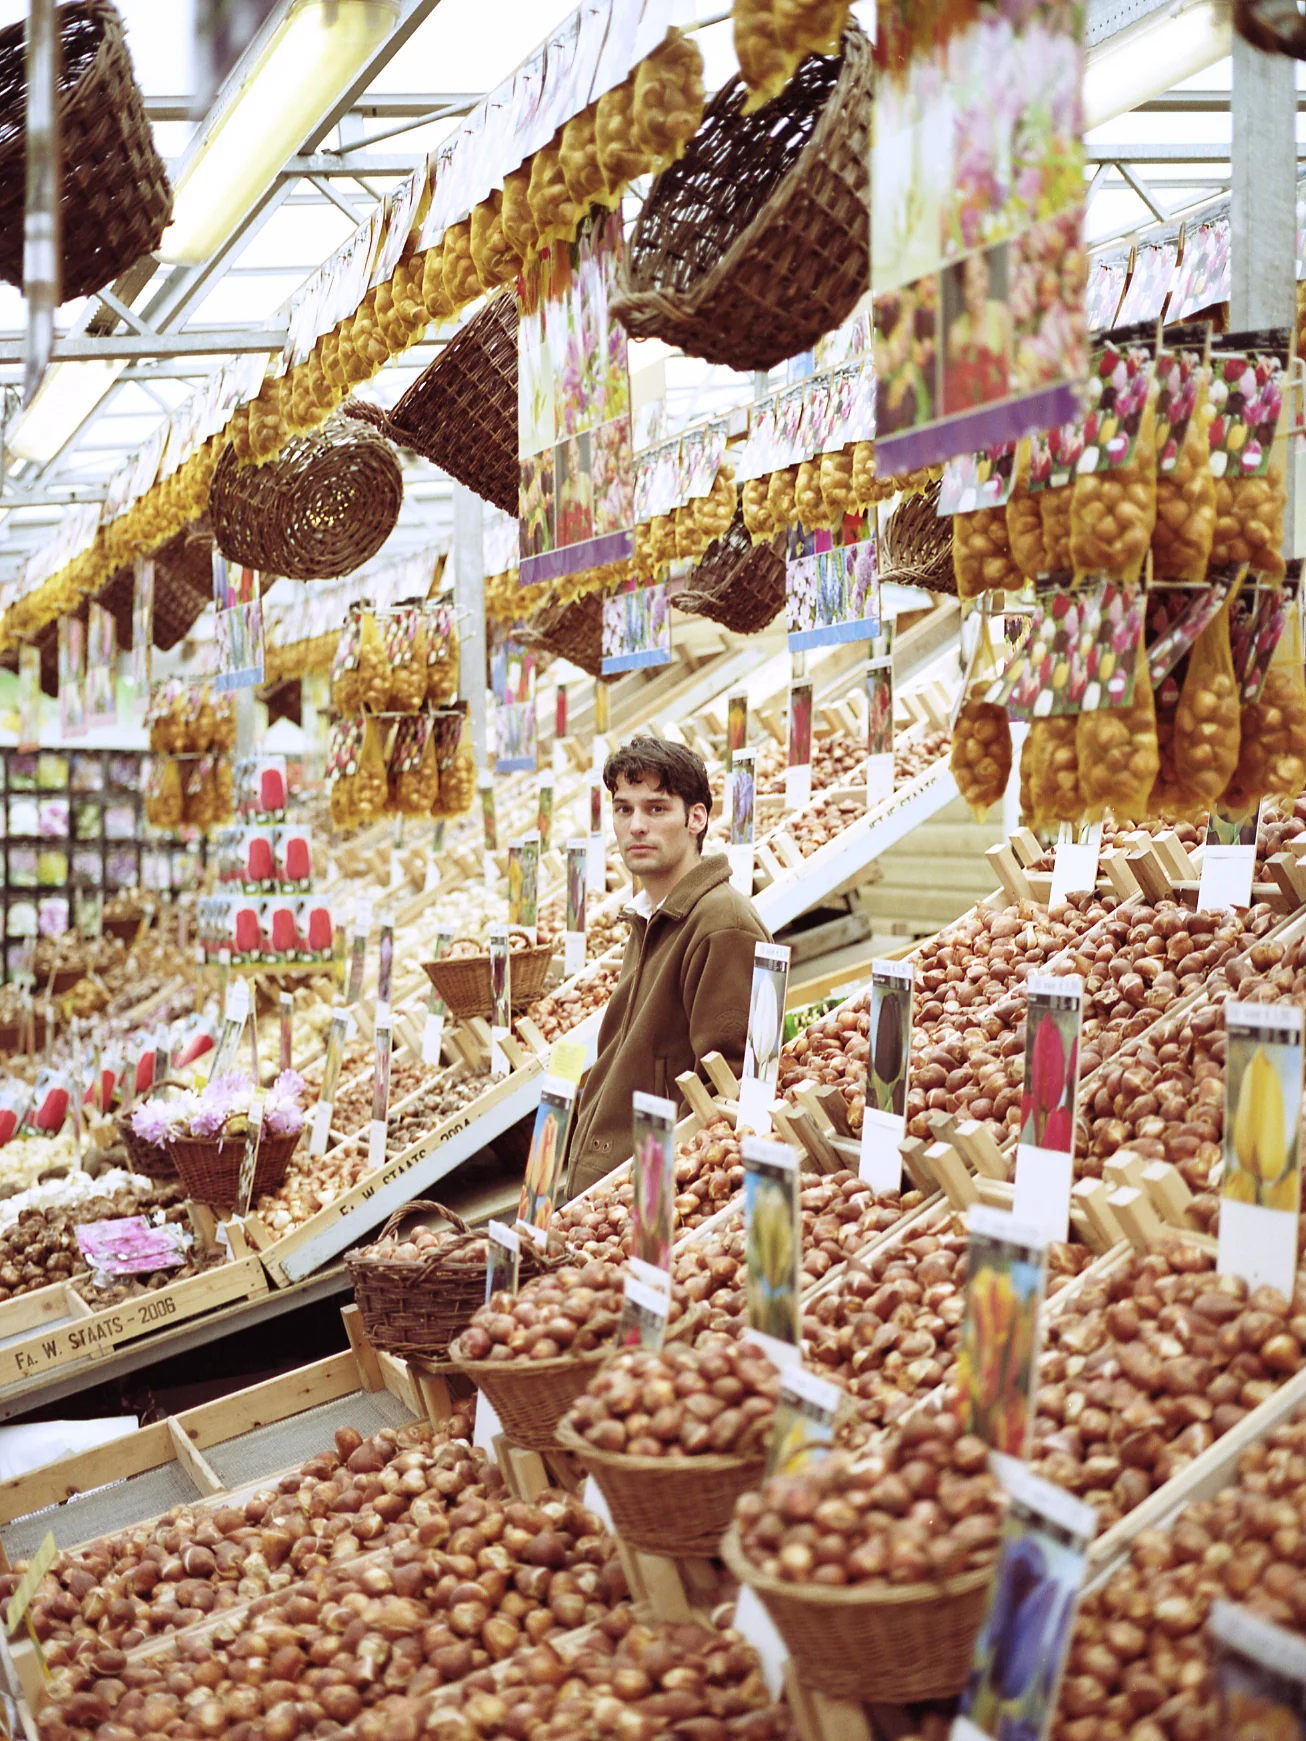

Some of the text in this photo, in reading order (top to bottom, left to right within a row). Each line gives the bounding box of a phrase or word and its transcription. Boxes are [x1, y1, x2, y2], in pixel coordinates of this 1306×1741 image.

[42, 1340, 63, 1359] W.
[68, 1316, 123, 1350] STAATS
[138, 1297, 177, 1325] 2006
